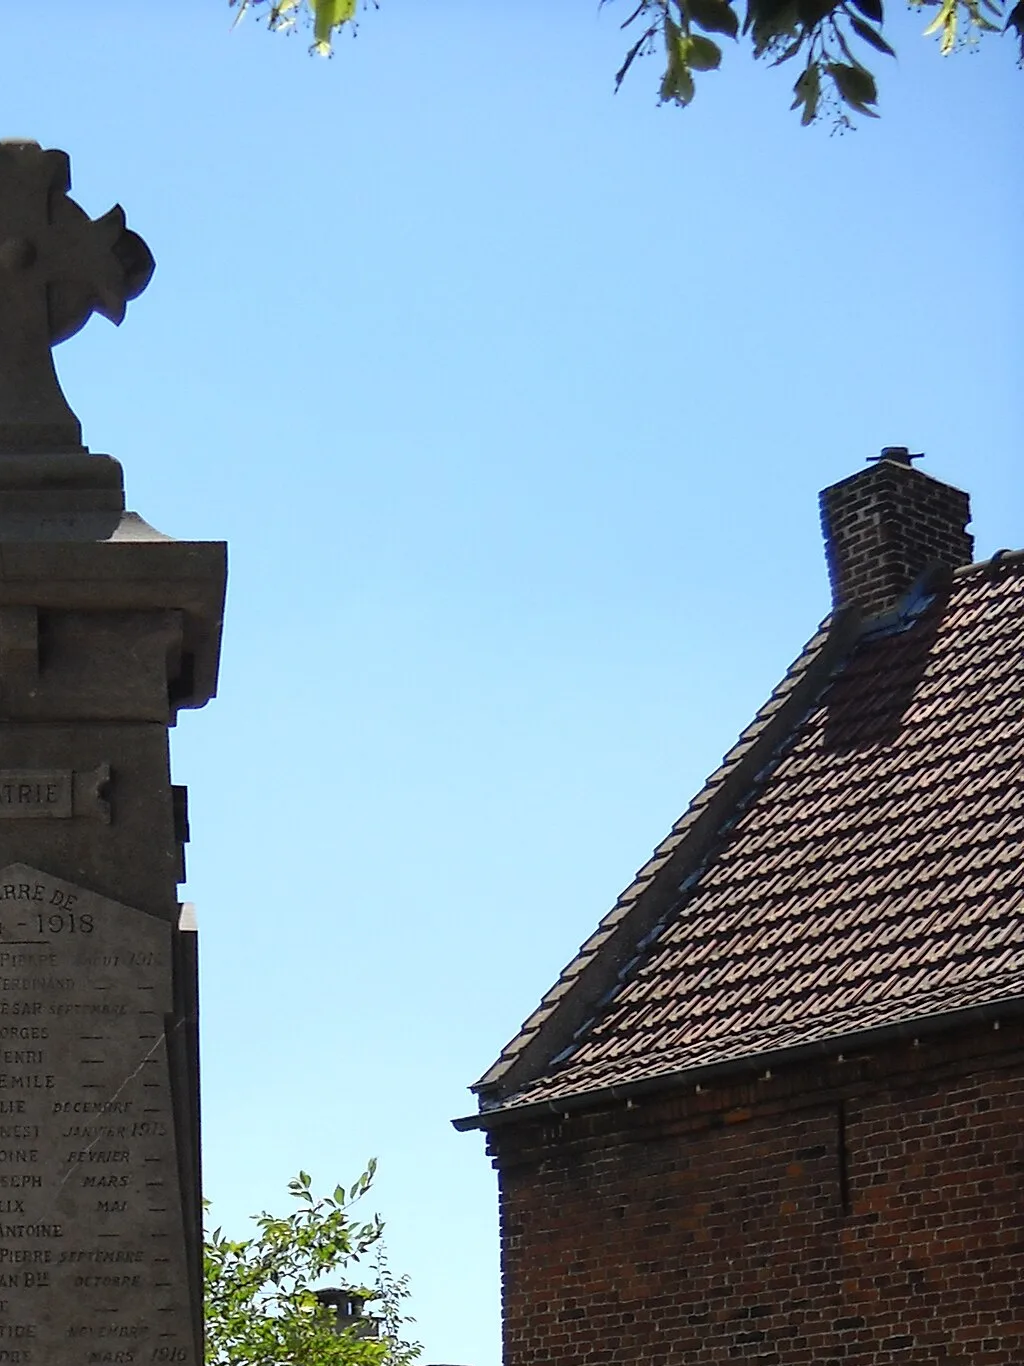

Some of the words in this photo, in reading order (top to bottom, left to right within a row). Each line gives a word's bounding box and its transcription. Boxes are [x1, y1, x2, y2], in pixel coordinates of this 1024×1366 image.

[49, 889, 78, 912] DE
[37, 913, 94, 934] 1918
[129, 952, 161, 967] 191
[82, 1175, 130, 1188] MARS
[96, 1200, 129, 1213] MAI
[0, 1247, 52, 1263] PIERRE
[59, 1250, 144, 1264] SEPTEMBRE
[74, 1275, 141, 1288] OCTOBRE
[88, 1350, 134, 1364] MARS
[151, 1346, 187, 1363] 1916
